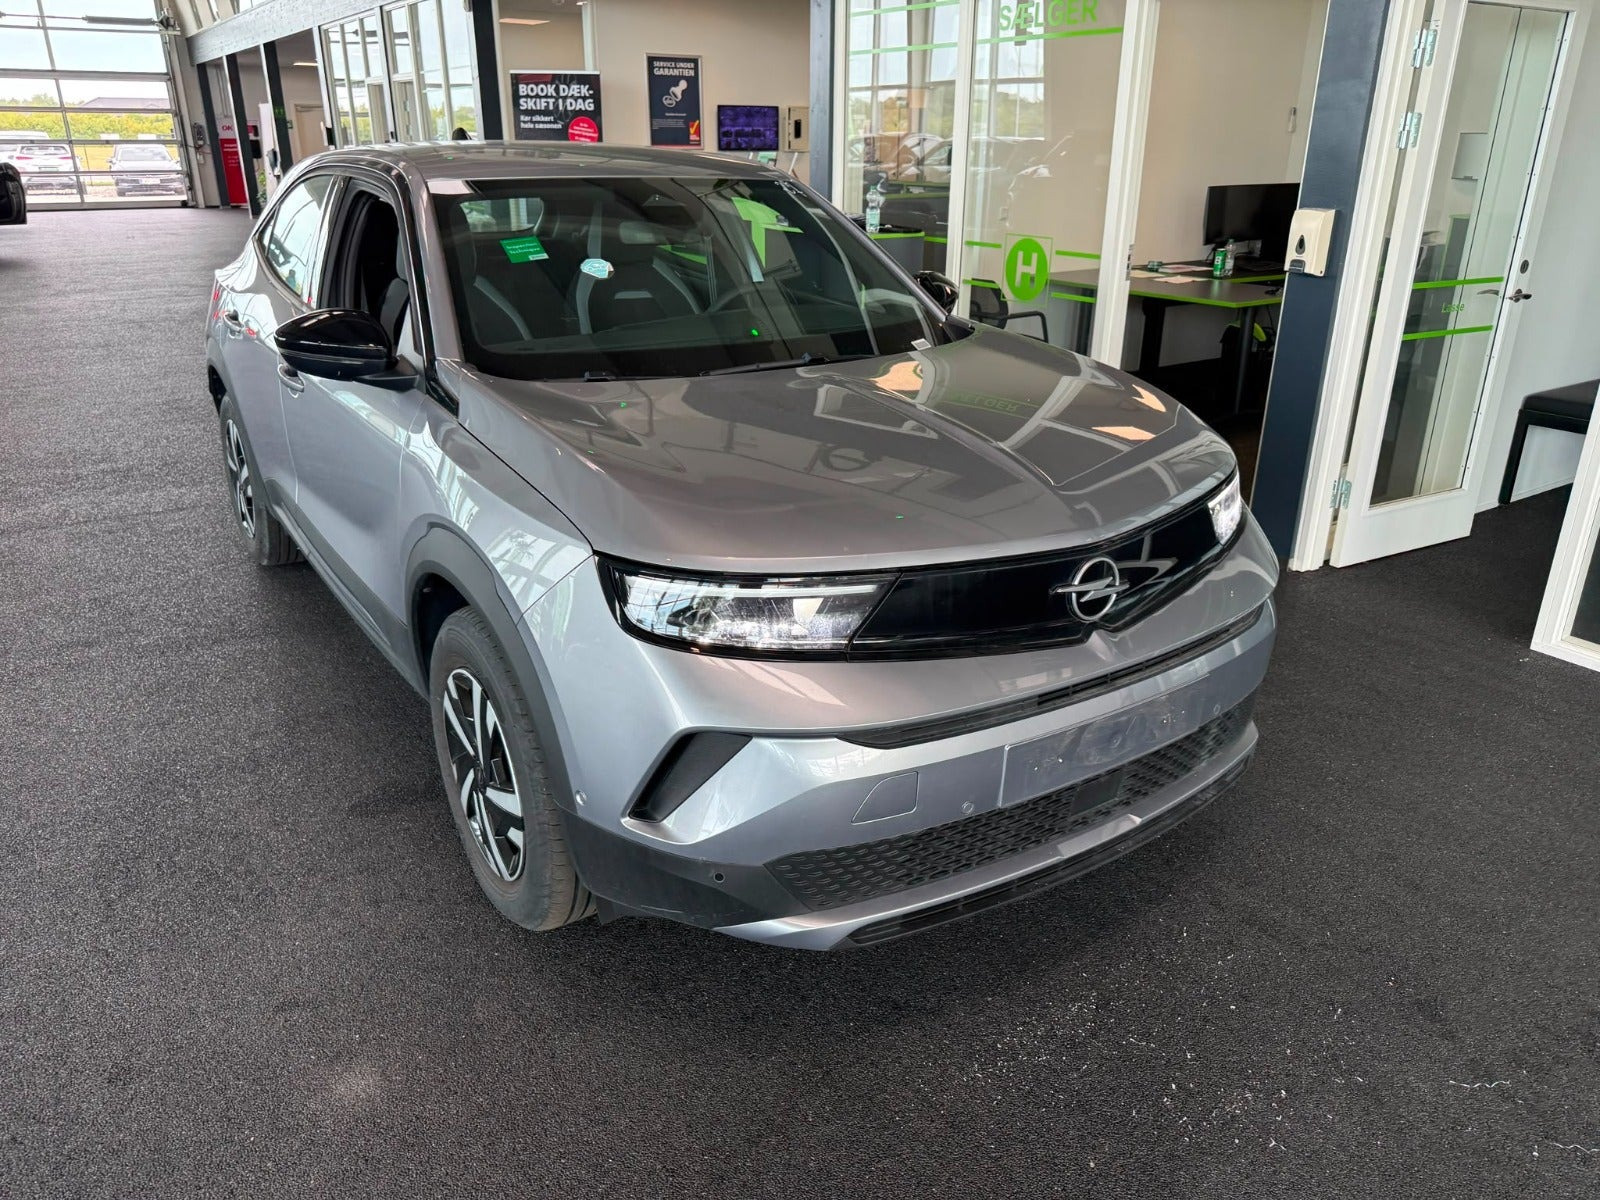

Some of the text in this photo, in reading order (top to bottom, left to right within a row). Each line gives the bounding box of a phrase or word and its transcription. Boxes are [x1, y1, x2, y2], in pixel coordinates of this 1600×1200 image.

[1000, 0, 1098, 31] SÆLGER
[653, 67, 695, 77] GARANTIEN
[518, 84, 594, 97] BOOK DÆK-
[519, 98, 595, 111] SKIFT I DAG
[1014, 250, 1038, 289] H
